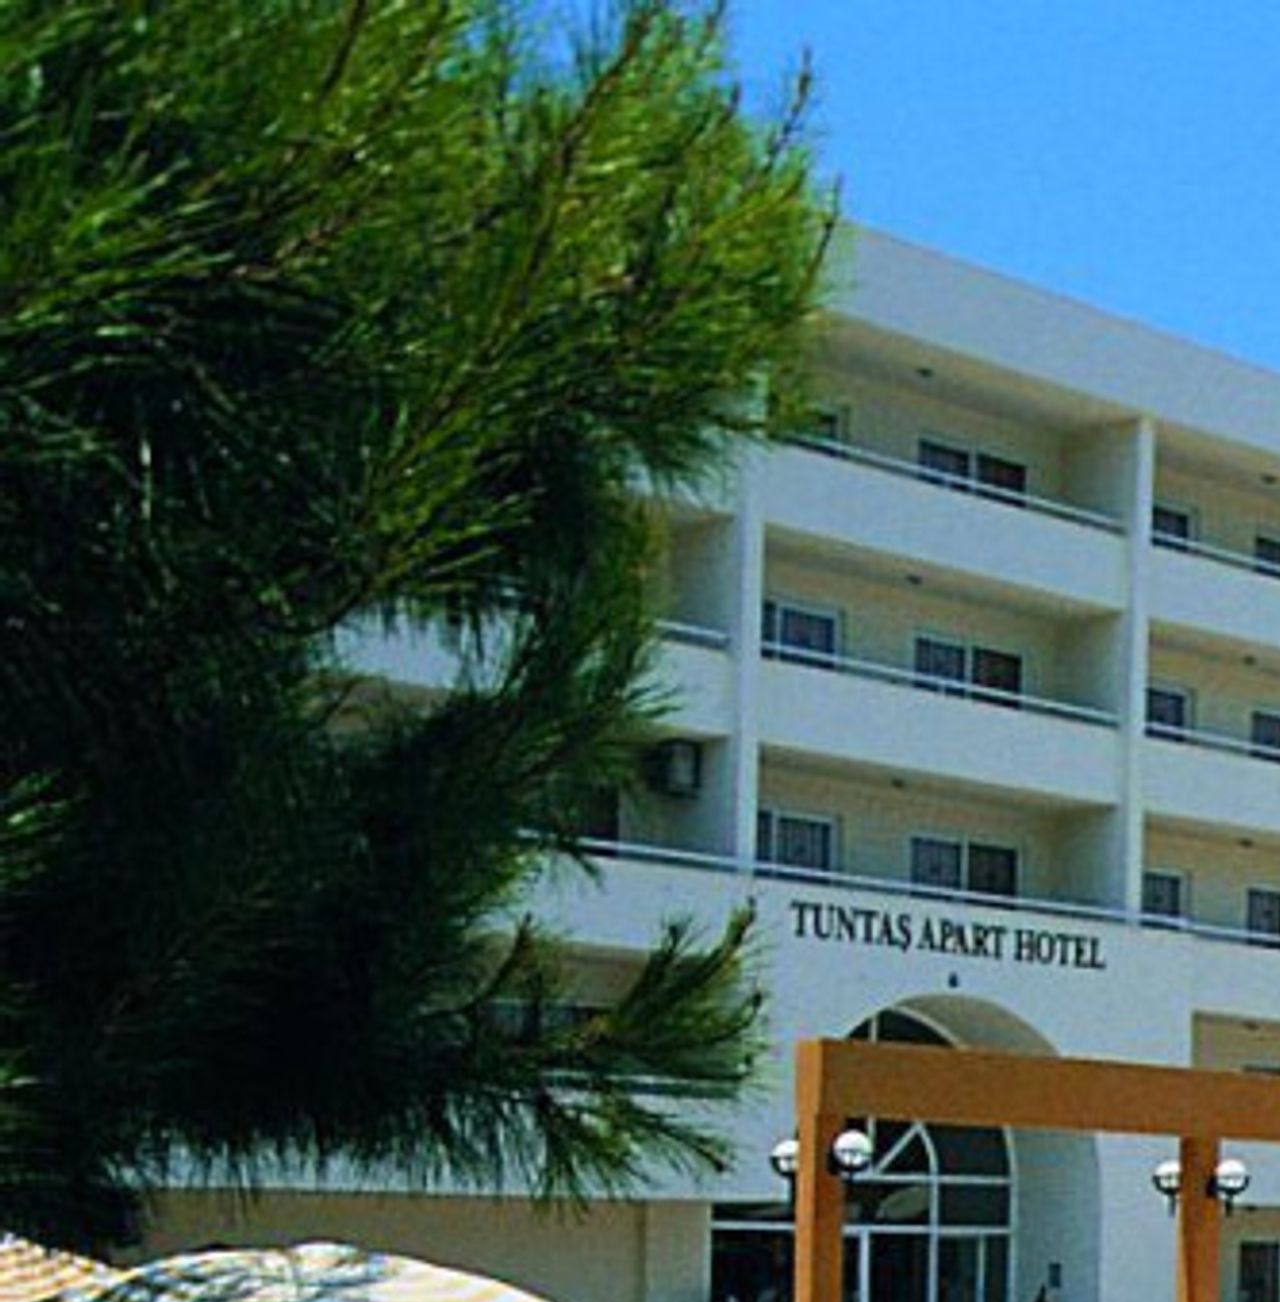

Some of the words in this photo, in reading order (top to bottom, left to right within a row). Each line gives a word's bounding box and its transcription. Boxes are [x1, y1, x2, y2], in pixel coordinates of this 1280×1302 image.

[791, 901, 911, 952] TUNTAŞ
[917, 916, 1008, 958] APART
[1013, 929, 1106, 969] HOTEL
